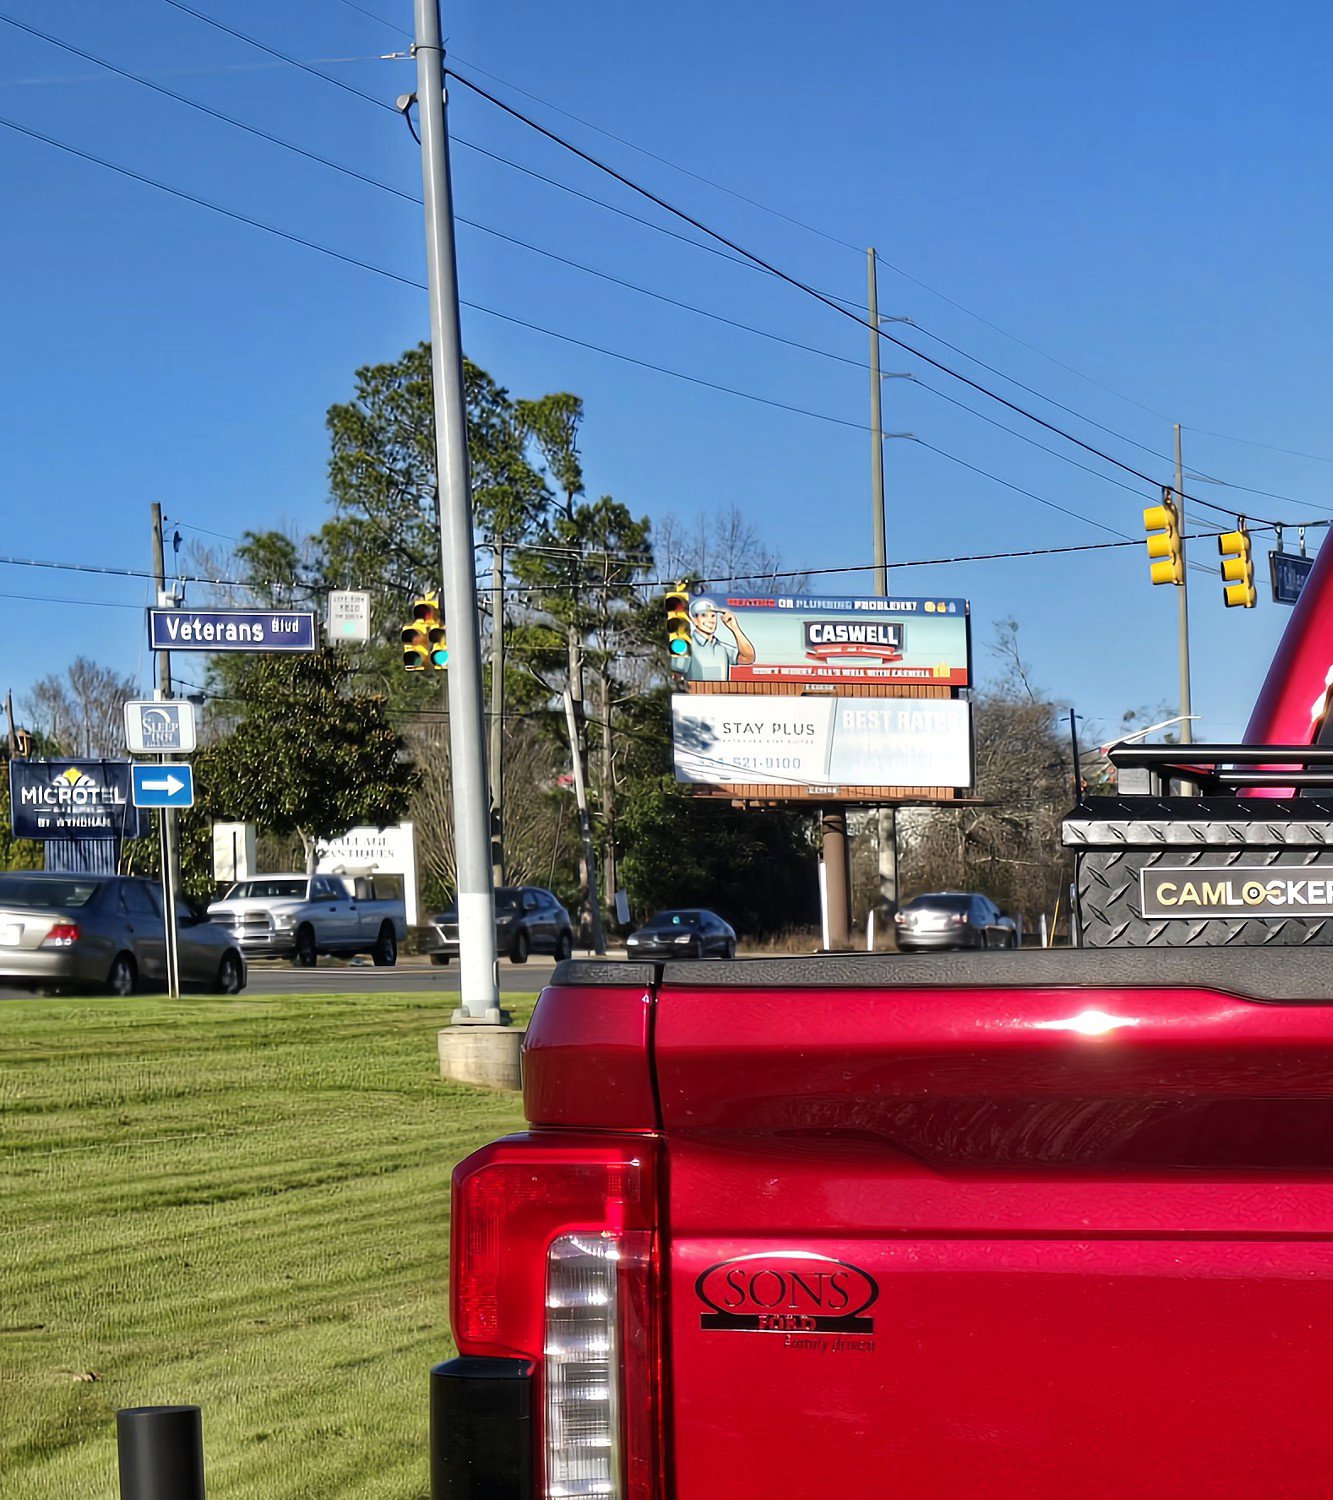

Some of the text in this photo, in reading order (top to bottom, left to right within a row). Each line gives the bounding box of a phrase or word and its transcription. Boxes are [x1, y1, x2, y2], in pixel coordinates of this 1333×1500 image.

[166, 616, 299, 642] Veterans Blvd
[809, 623, 899, 645] CASWELL
[722, 722, 815, 736] STAY PLUS
[20, 785, 127, 805] MICROTEL
[723, 1269, 849, 1309] SONS
